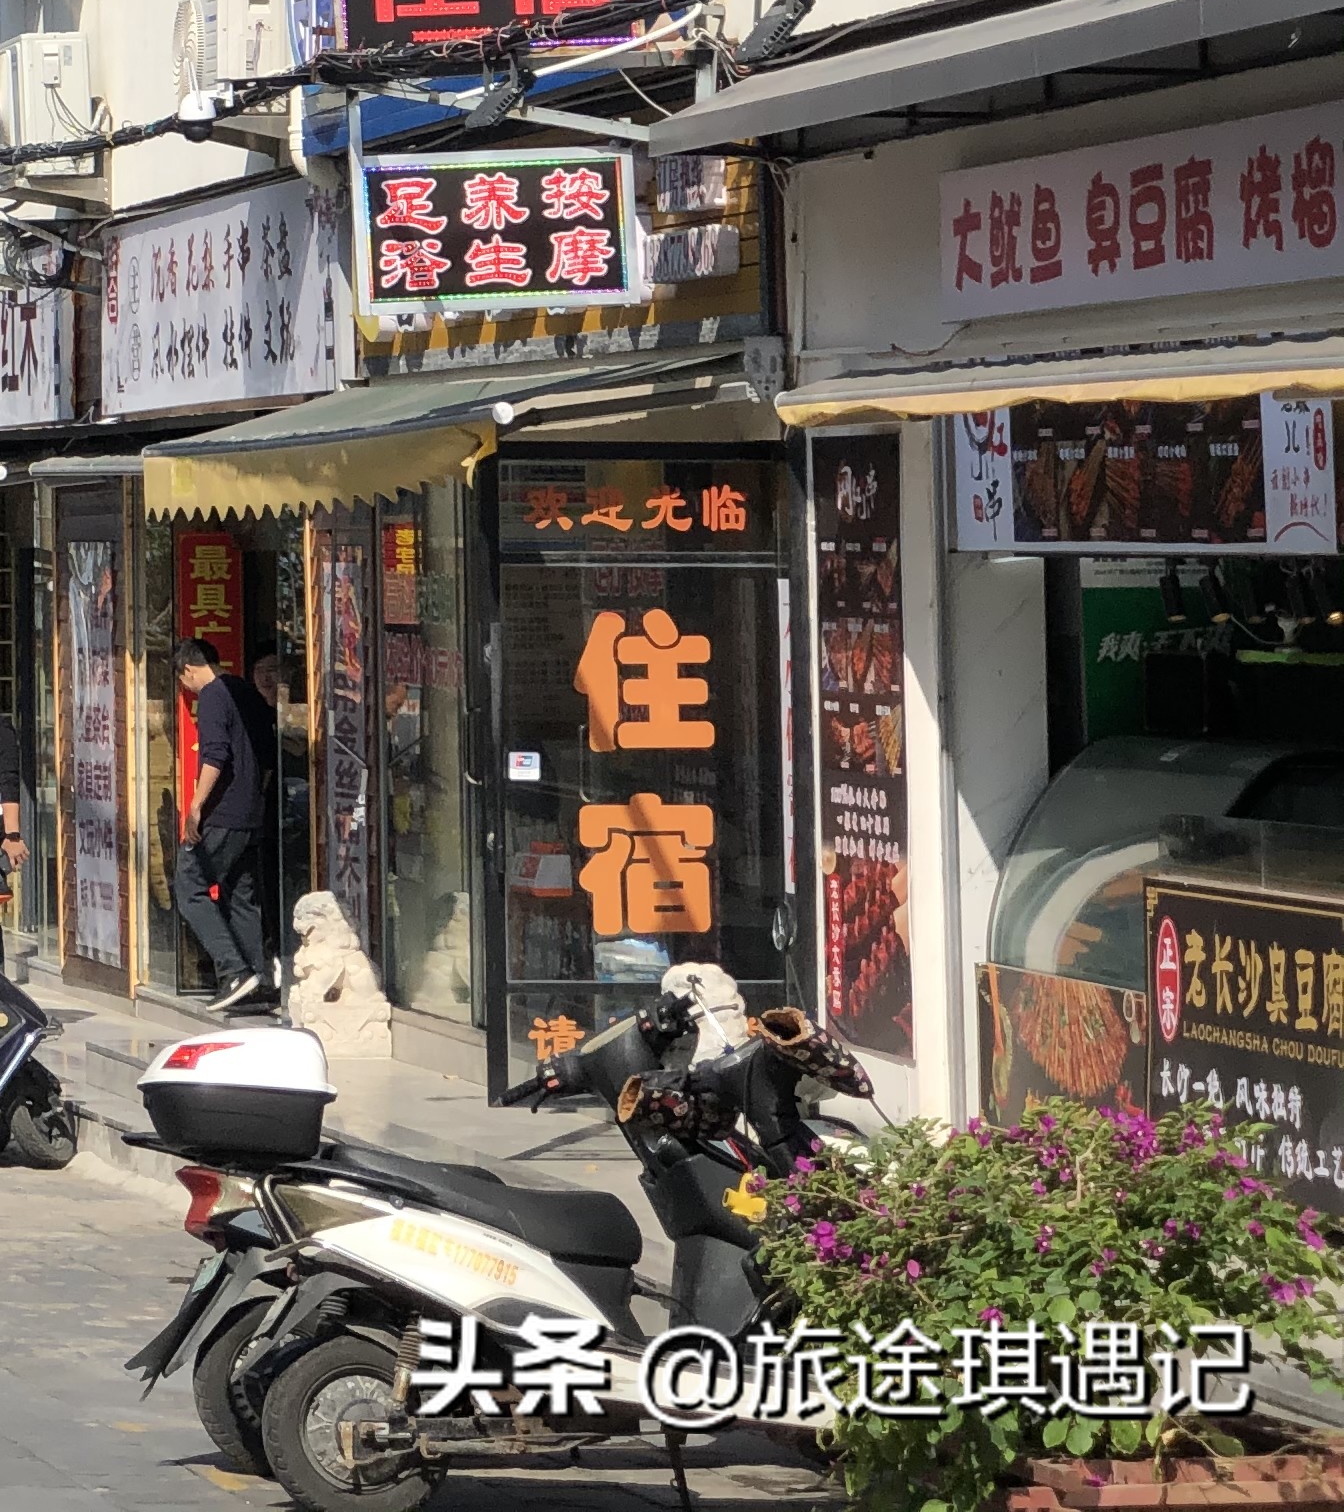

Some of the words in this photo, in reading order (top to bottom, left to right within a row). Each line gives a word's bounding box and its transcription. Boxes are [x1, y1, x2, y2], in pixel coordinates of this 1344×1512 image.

[376, 176, 451, 291] 足浴
[461, 172, 532, 287] 养生
[541, 167, 616, 286] 按摩
[952, 184, 1063, 292] 大鱿鱼
[1085, 155, 1215, 277] 臭豆腐
[1240, 135, 1337, 252] 烤榴
[523, 484, 748, 533] 欢迎光临
[573, 608, 715, 935] 住宿
[1160, 938, 1176, 1030] 正宗
[1184, 929, 1344, 1038] 老长沙臭豆腐
[1183, 1020, 1269, 1053] LAOCHANGSHA
[1272, 1039, 1303, 1061] CHOU
[1307, 1043, 1344, 1069] DOUFU
